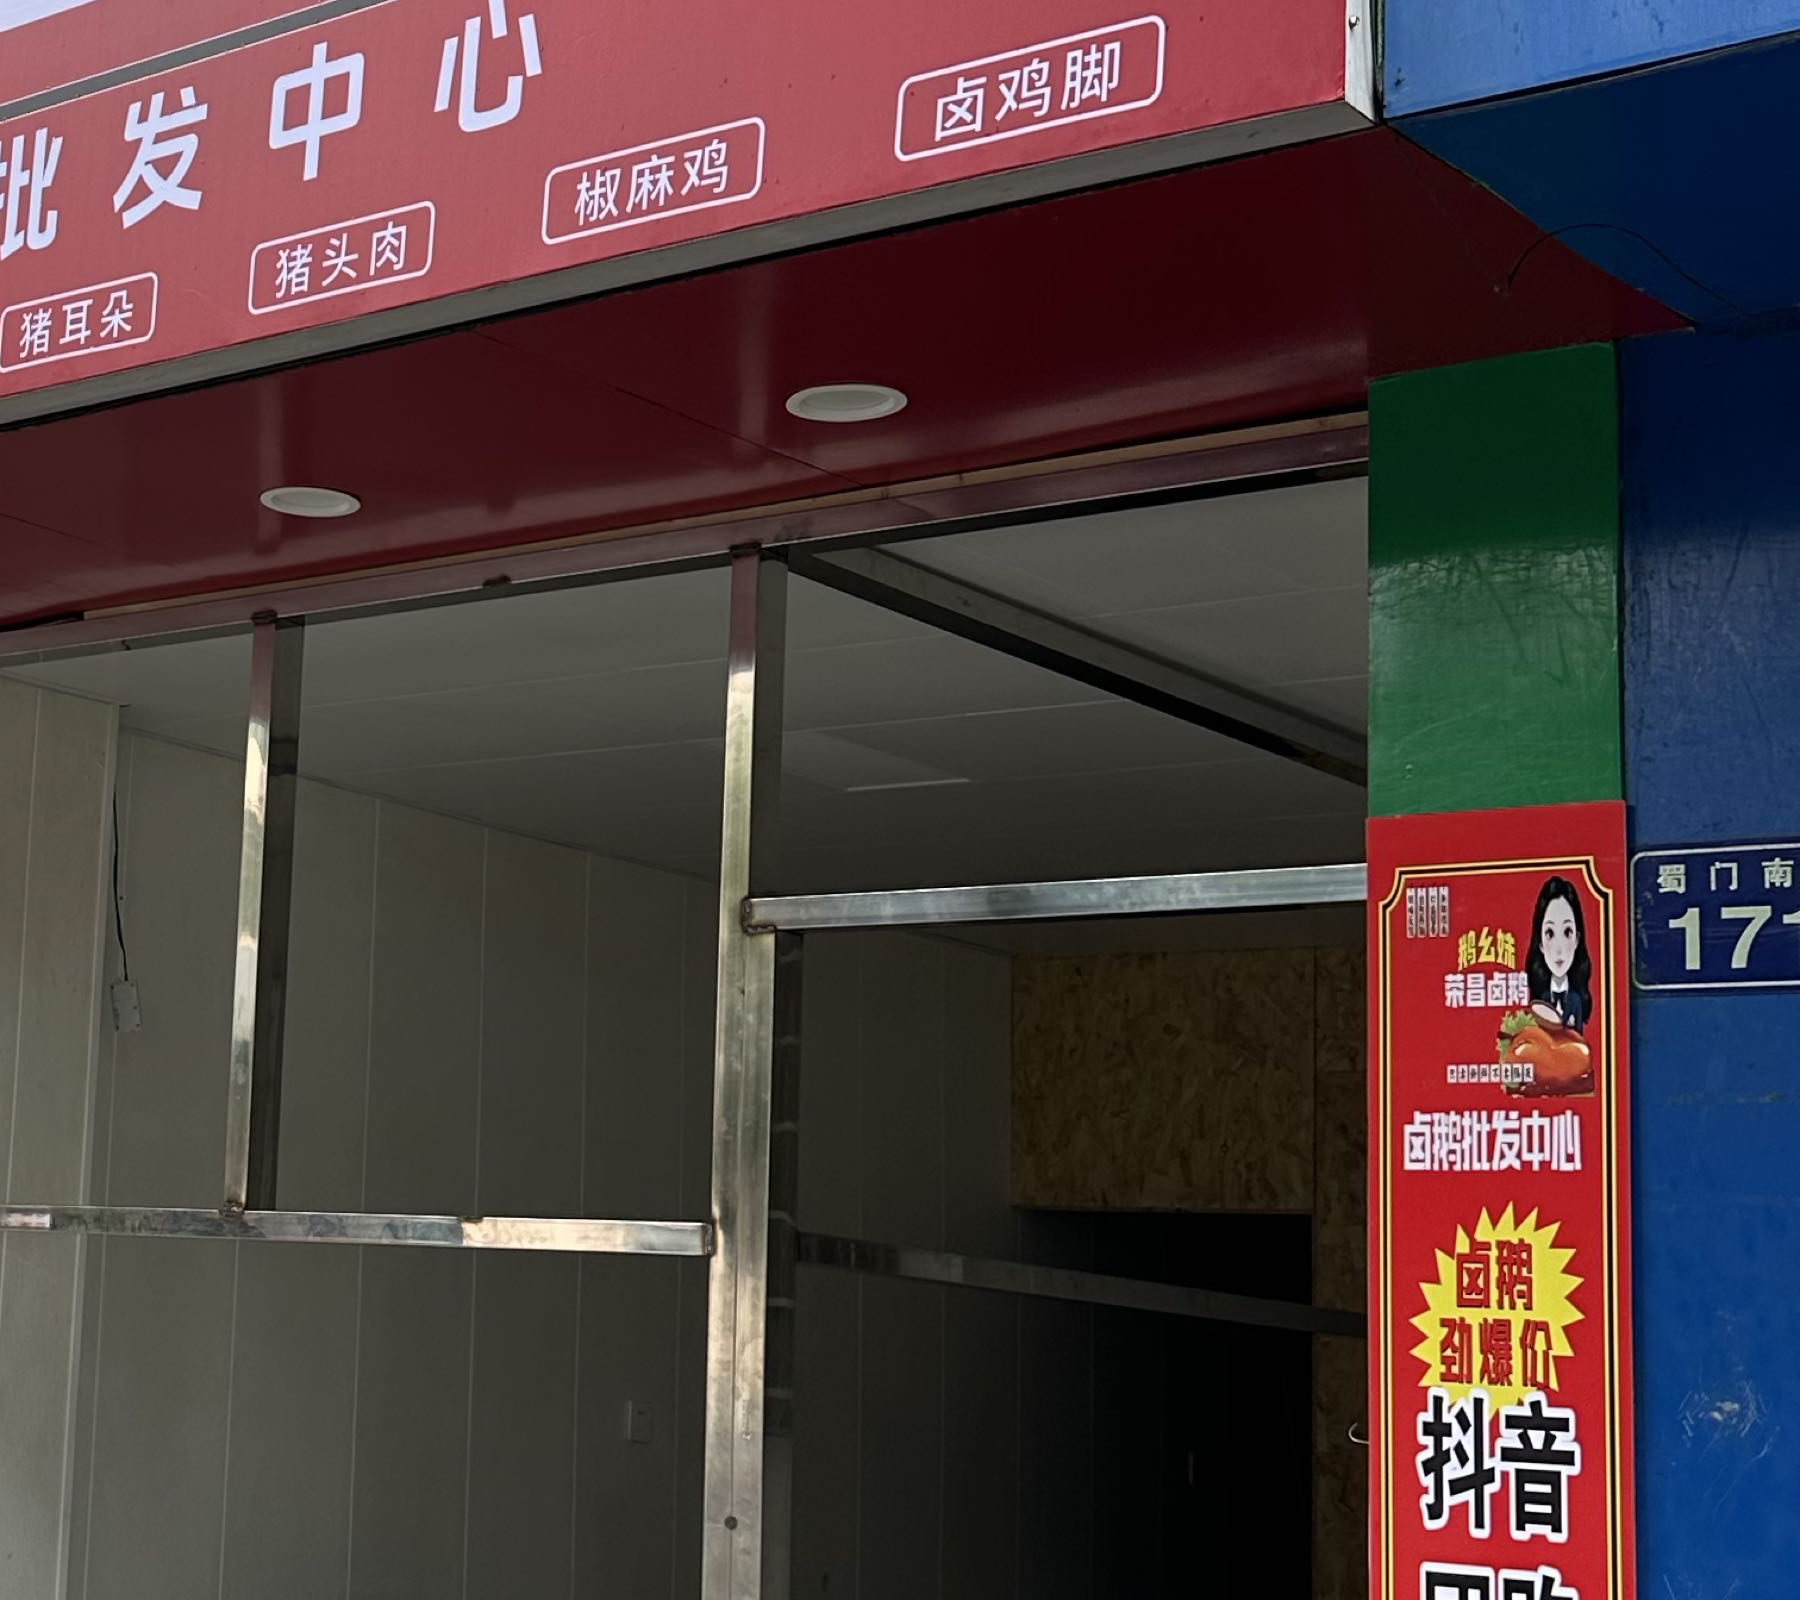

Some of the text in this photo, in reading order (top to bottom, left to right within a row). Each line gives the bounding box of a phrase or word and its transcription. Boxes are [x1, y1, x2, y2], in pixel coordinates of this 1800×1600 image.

[933, 43, 1121, 137] 卤鸡脚
[574, 137, 731, 222] 椒麻鸡
[275, 221, 409, 296] 猪头肉
[17, 288, 134, 358] 猪耳朵
[1656, 856, 1794, 894] 蜀门南
[1444, 971, 1530, 1008] 荣昌卤鹅
[1402, 1109, 1583, 1172] 卤鹅批发中心
[1455, 1238, 1533, 1311] 卤鹅
[1438, 1318, 1556, 1388] 劲爆价
[1419, 1389, 1580, 1541] 抖音
